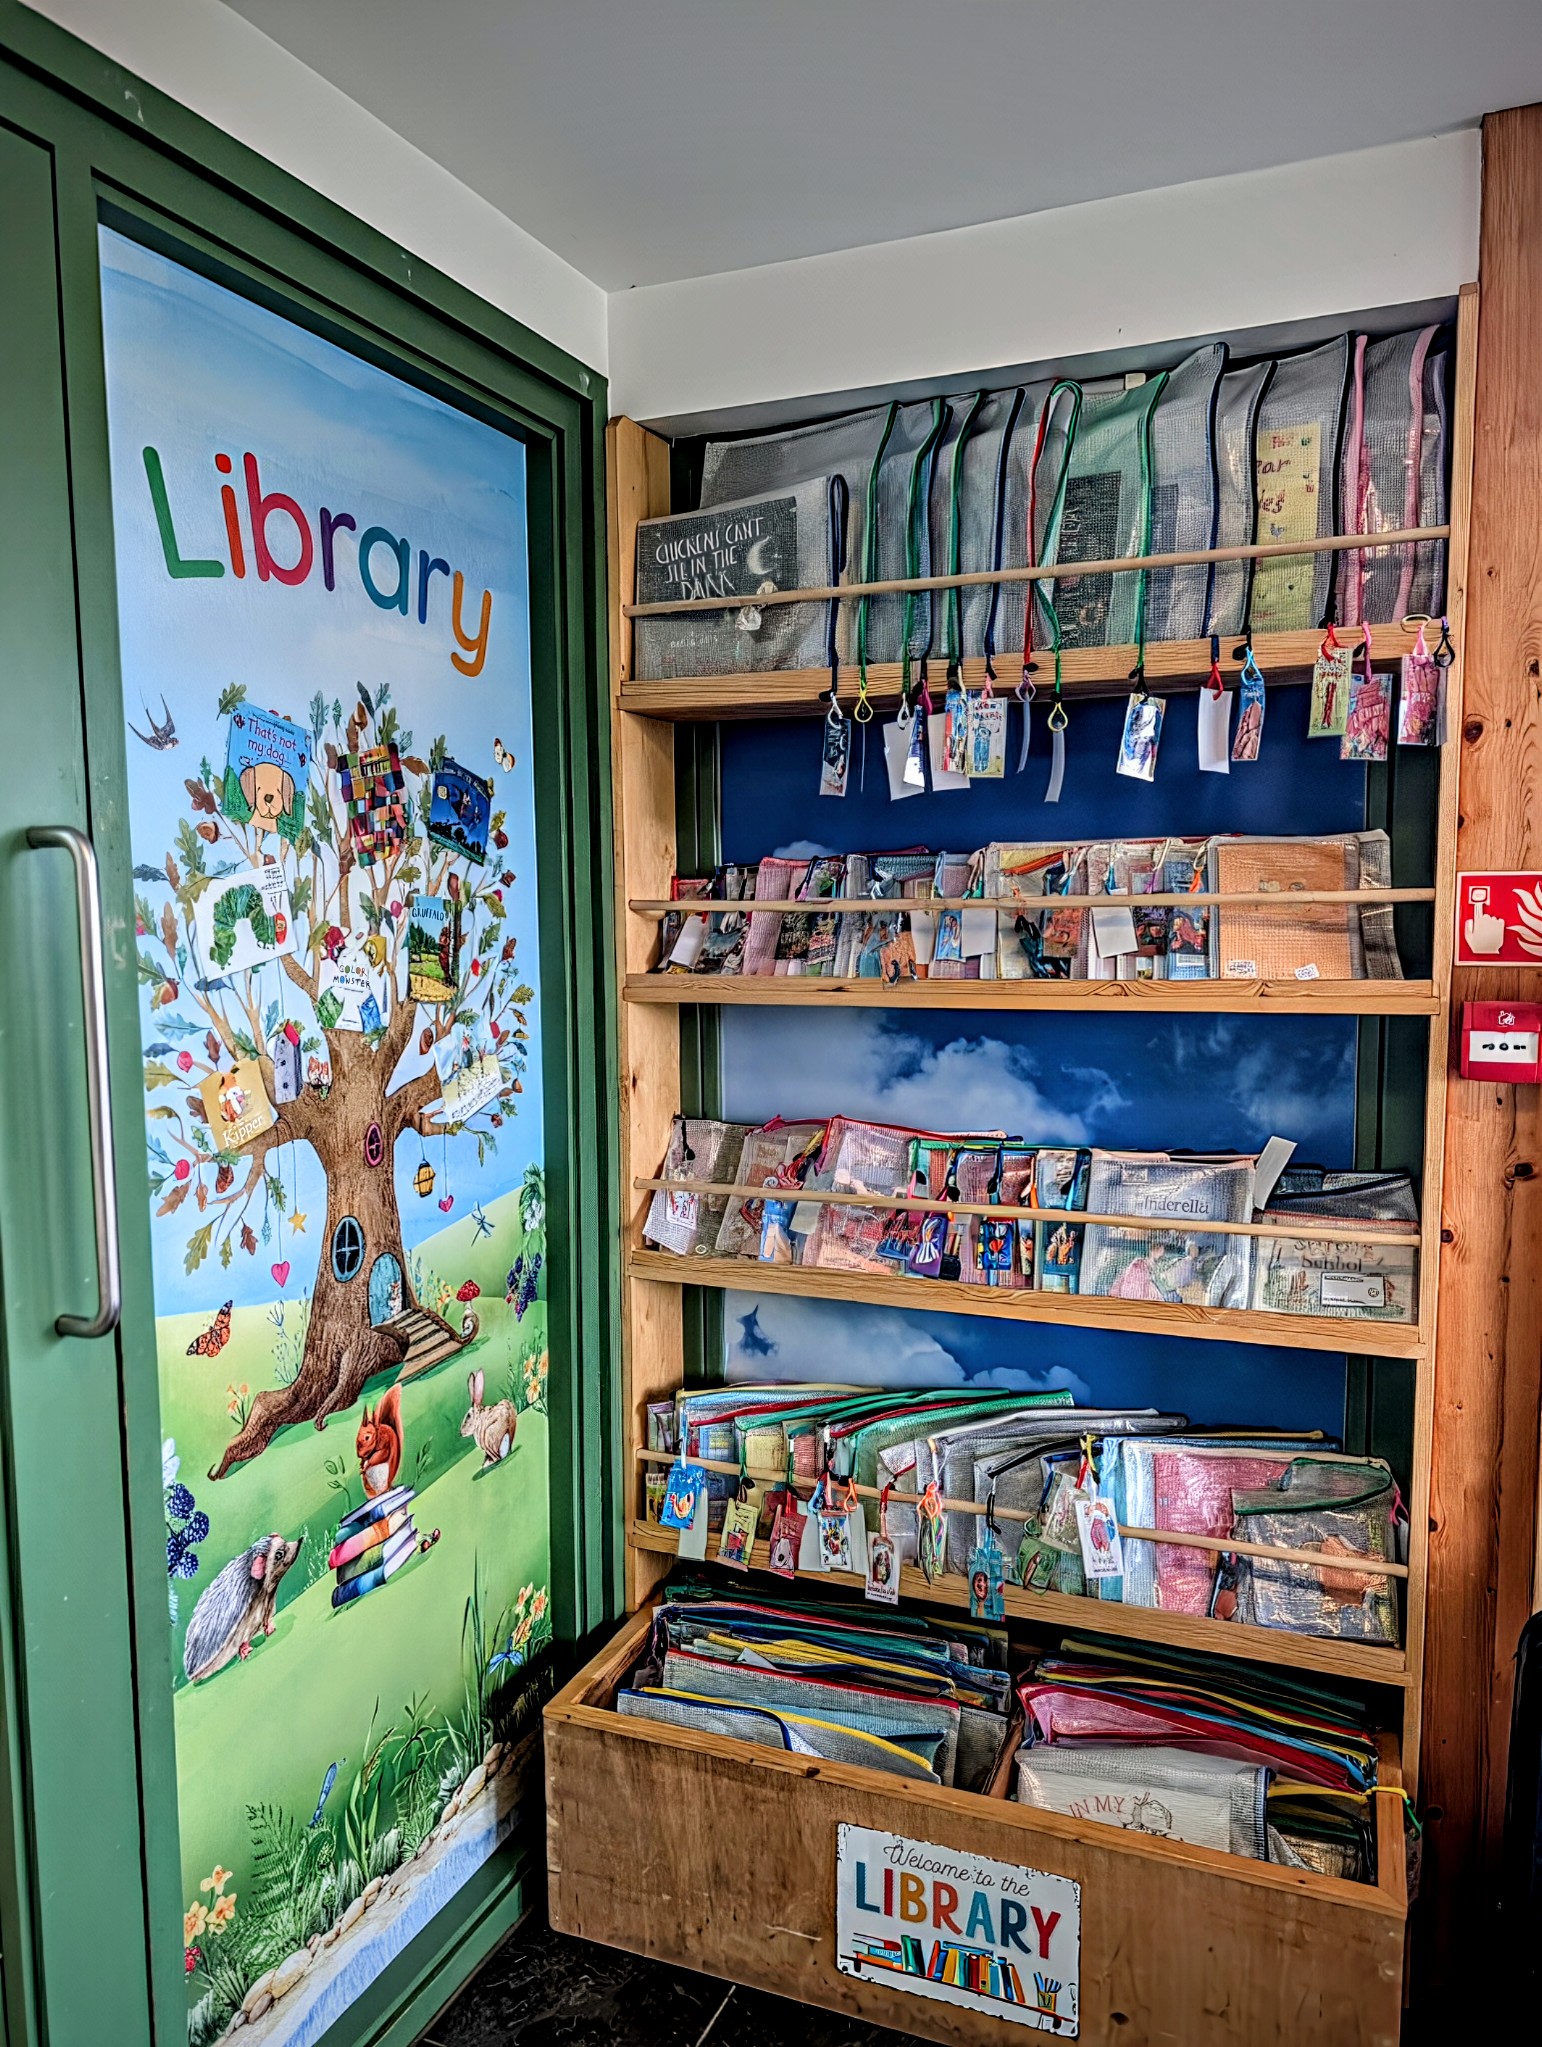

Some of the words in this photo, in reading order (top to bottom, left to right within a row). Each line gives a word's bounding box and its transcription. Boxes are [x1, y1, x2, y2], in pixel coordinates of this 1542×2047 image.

[143, 446, 492, 678] Library
[690, 556, 707, 577] IN
[711, 545, 738, 570] THE
[248, 716, 278, 744] That's
[279, 735, 297, 753] not
[247, 739, 264, 757] my
[266, 743, 285, 767] dog
[411, 907, 445, 921] GRUFFALO
[332, 975, 372, 989] MONSTER
[339, 963, 368, 980] COLOR
[221, 1114, 265, 1148] Kipper
[1069, 1798, 1090, 1819] IN
[1094, 1795, 1125, 1813] MY
[883, 1844, 971, 1882] Welcome
[973, 1866, 996, 1888] to
[1000, 1873, 1031, 1898] the
[855, 1861, 1062, 1960] LIBRARY
